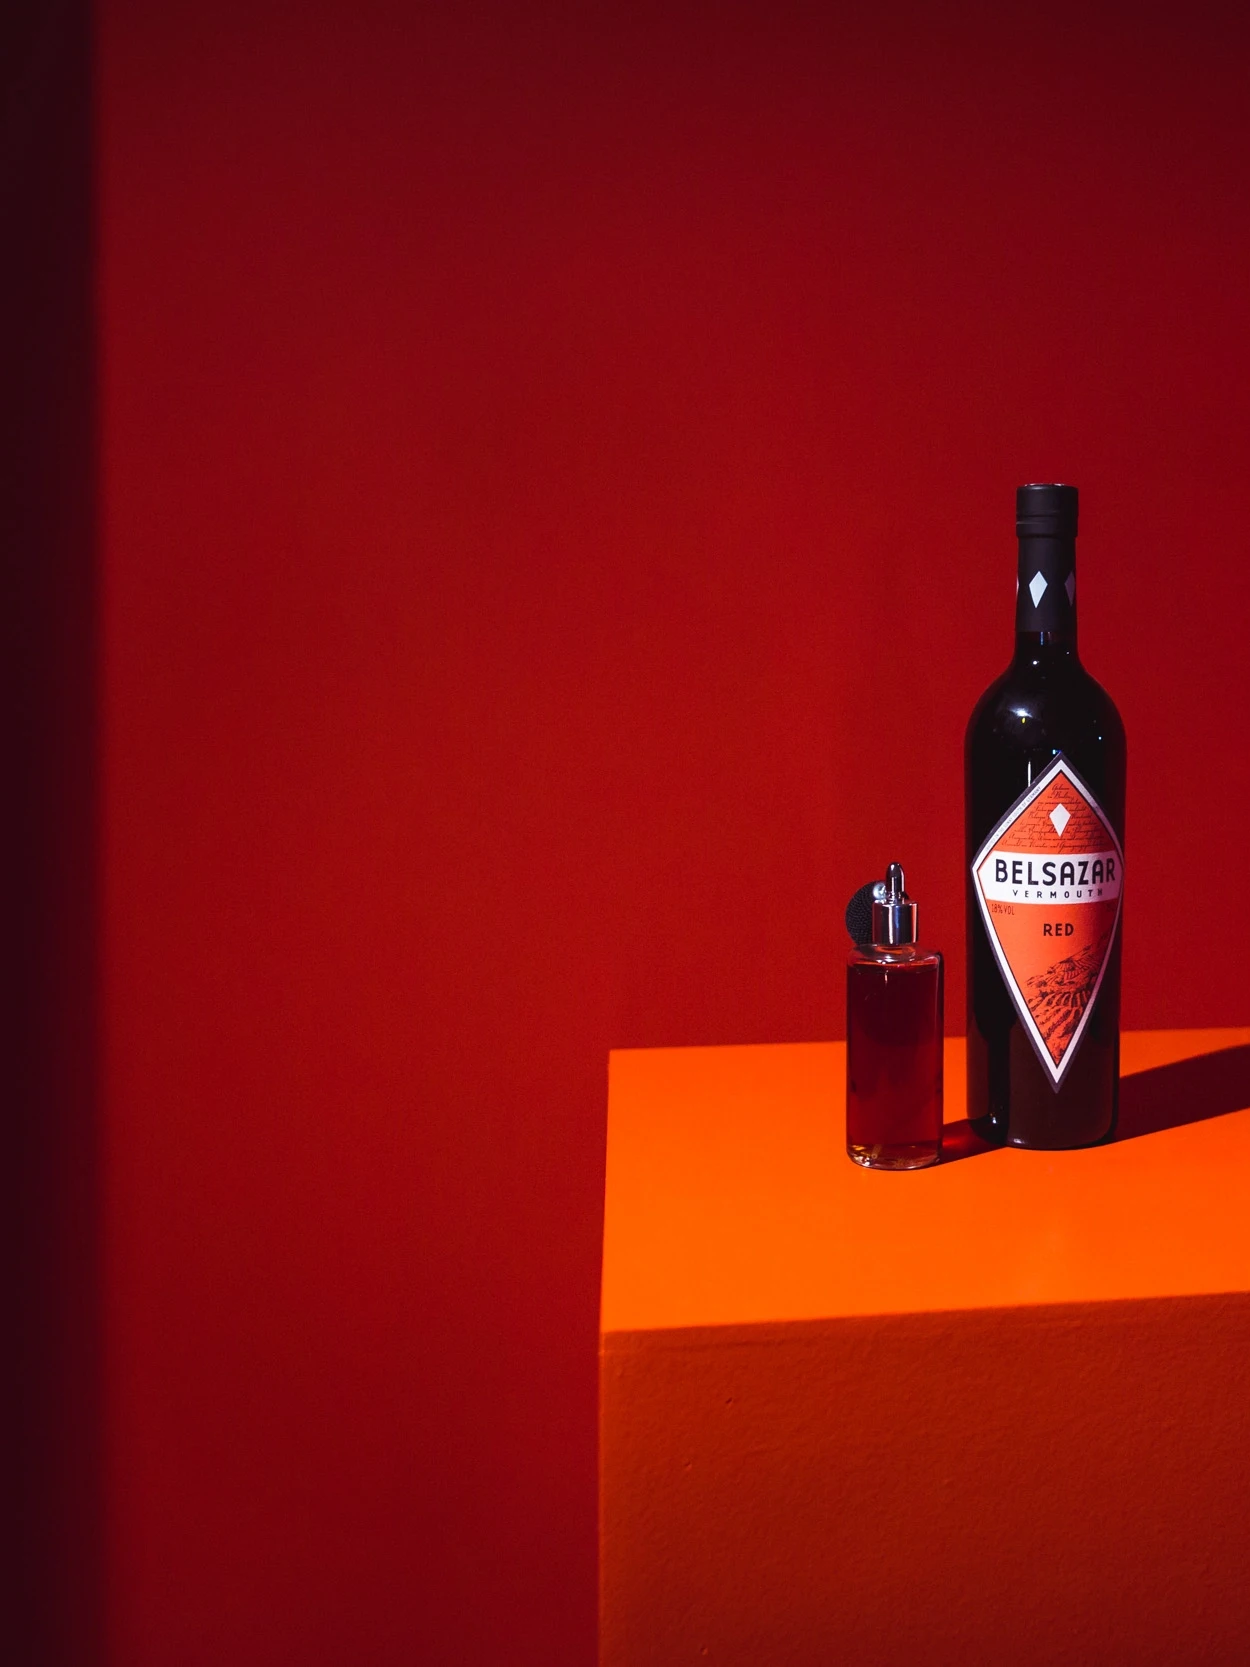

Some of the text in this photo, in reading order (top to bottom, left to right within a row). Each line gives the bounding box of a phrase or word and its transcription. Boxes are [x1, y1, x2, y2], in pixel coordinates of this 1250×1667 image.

[995, 858, 1115, 886] BELSAZAR
[1013, 889, 1103, 899] VERMOUTH
[1043, 923, 1075, 937] RED
